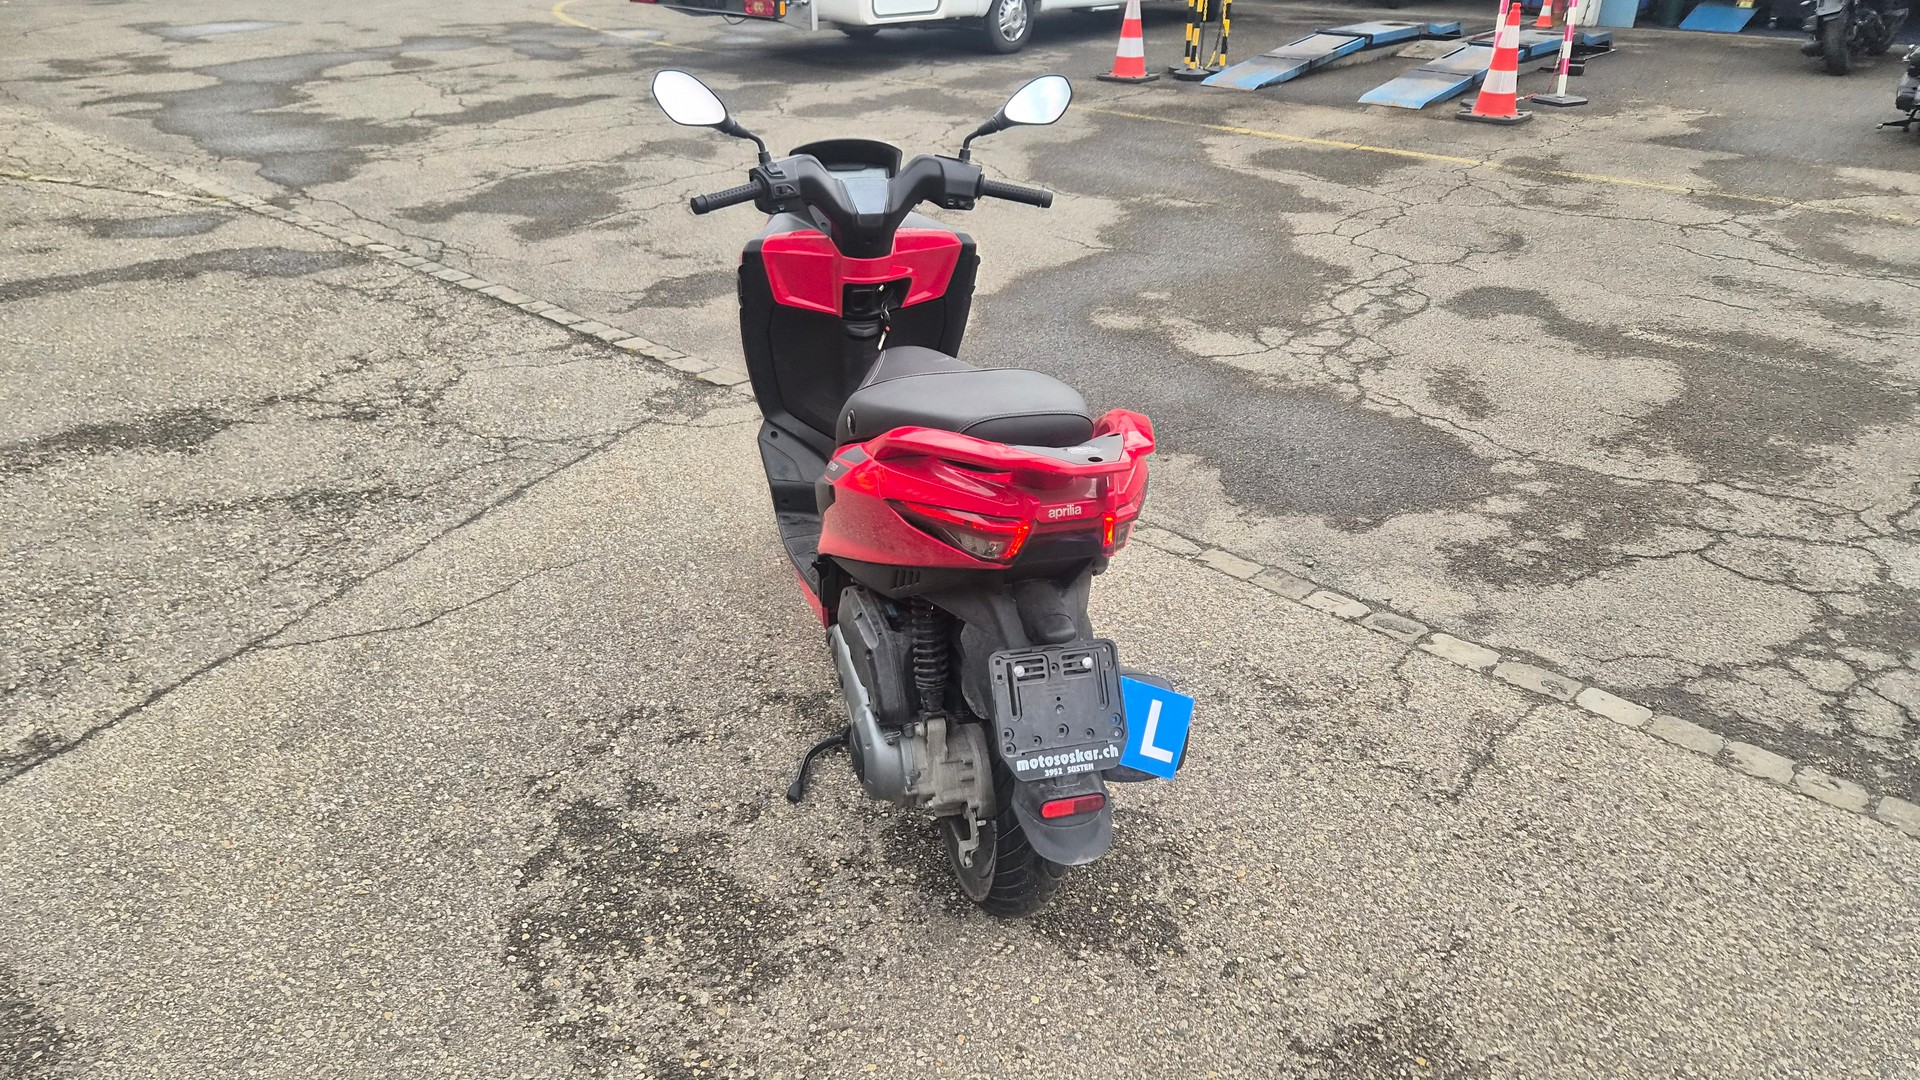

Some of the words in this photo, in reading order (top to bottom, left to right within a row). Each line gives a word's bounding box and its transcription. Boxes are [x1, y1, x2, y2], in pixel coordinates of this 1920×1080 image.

[1048, 504, 1082, 520] aprilia
[1140, 699, 1173, 763] L
[1016, 744, 1119, 772] motososkar.ch
[1044, 767, 1063, 777] 3952
